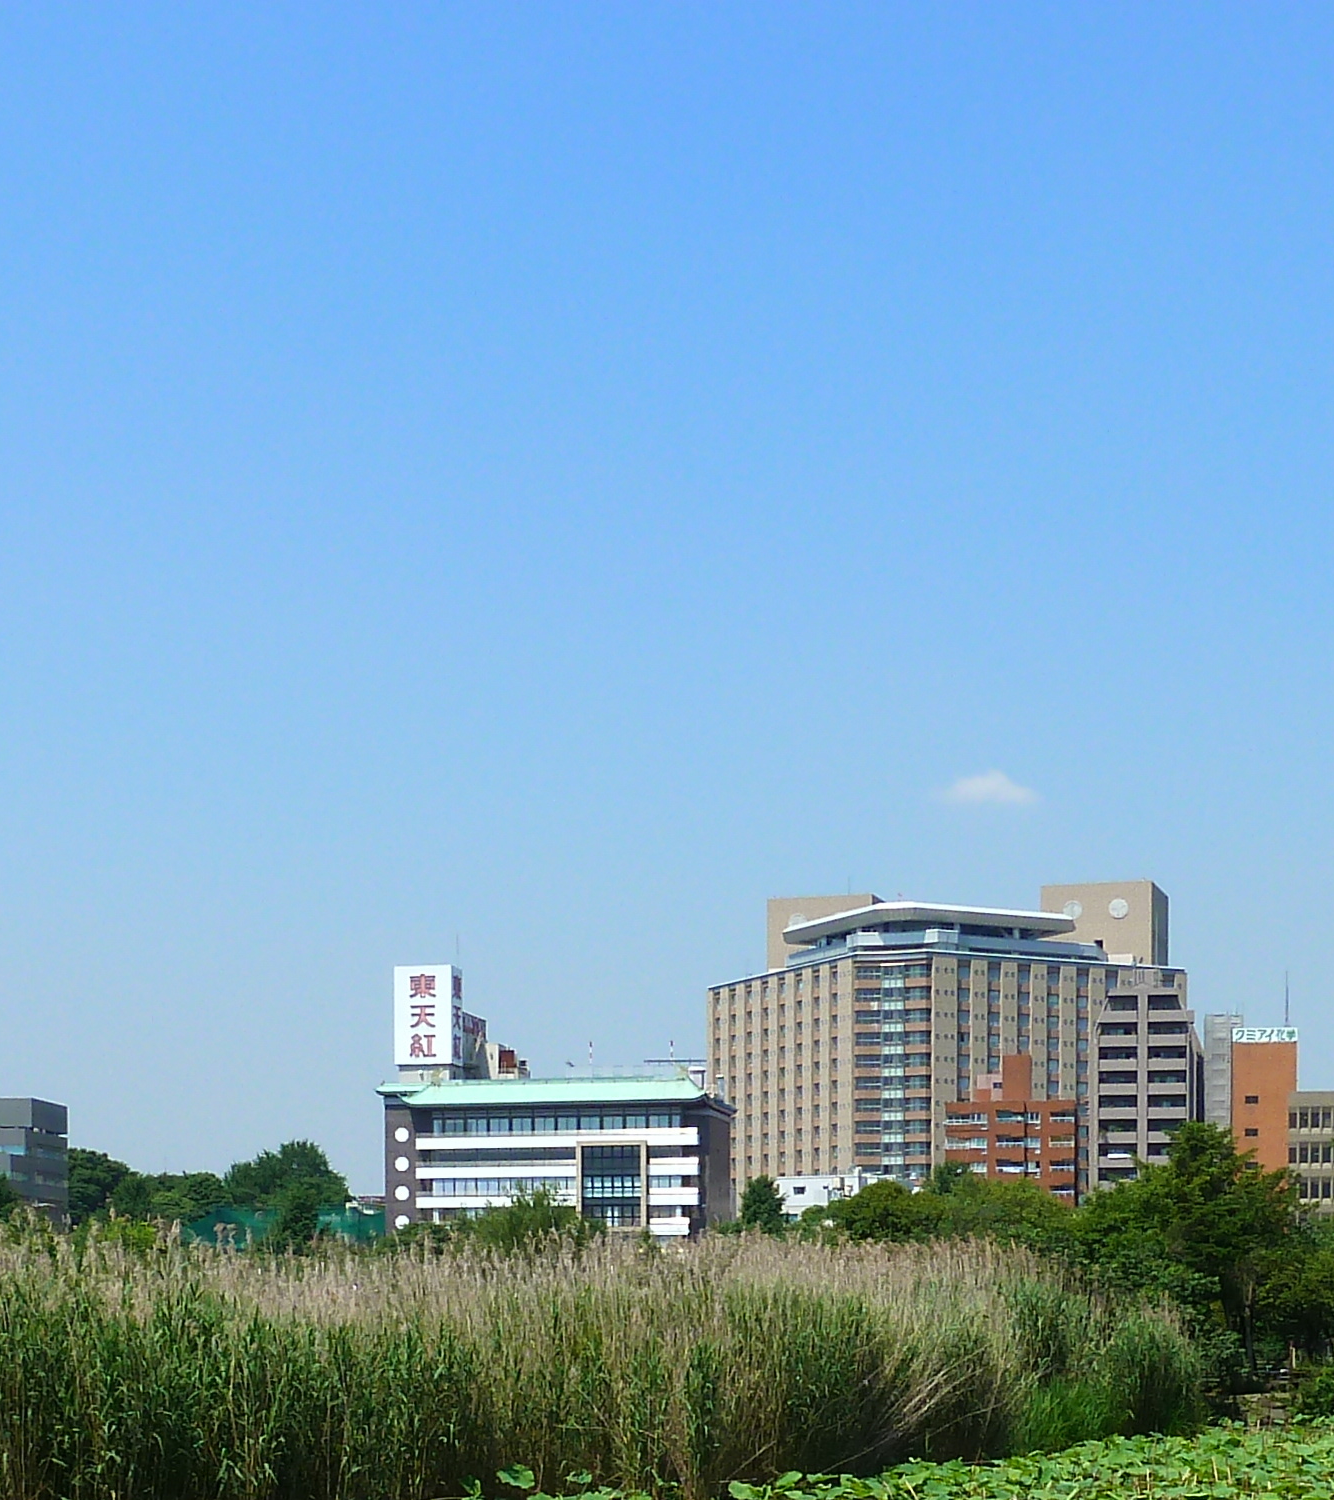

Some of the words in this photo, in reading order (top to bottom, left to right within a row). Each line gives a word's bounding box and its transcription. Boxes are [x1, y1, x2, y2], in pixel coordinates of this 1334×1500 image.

[409, 973, 437, 1058] 東天紅
[1235, 1028, 1296, 1042] クミアイ化学
